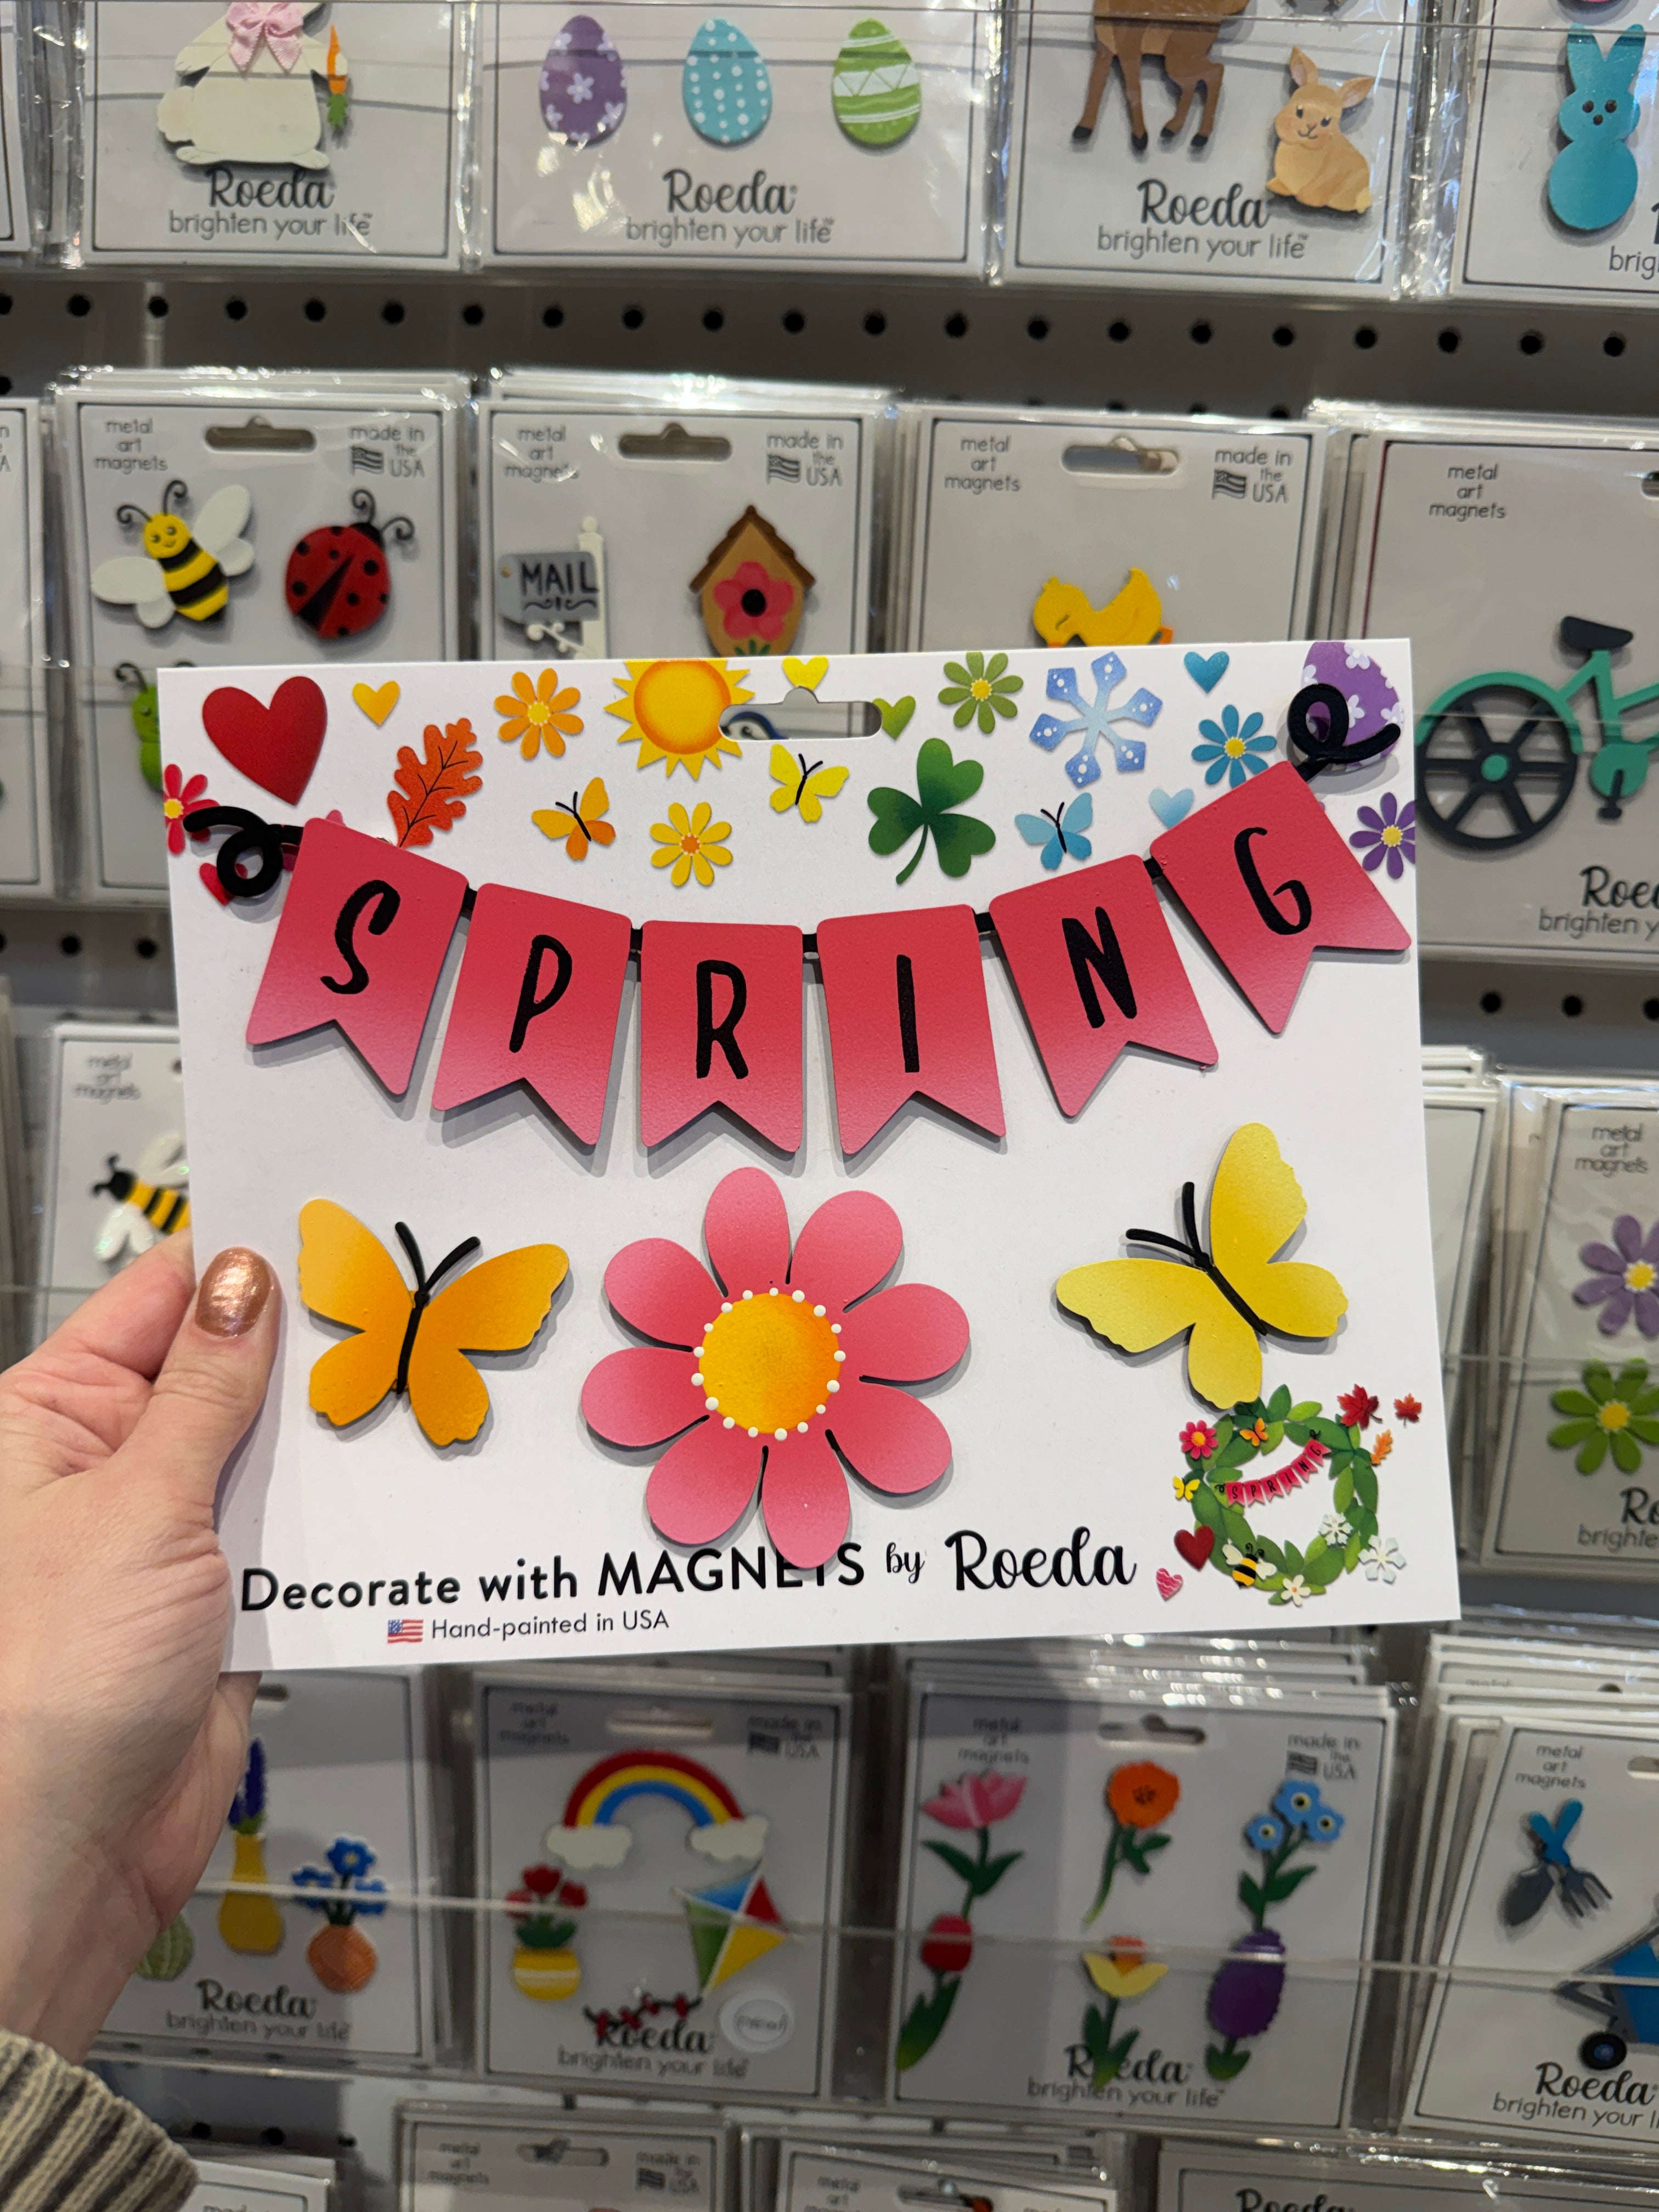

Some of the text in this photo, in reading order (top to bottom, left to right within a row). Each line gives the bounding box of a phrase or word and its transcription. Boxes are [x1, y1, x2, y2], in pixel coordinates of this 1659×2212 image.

[205, 166, 335, 209] Roeda
[1137, 178, 1271, 228] Roeda
[169, 210, 267, 241] brighten
[274, 219, 327, 241] your
[626, 217, 726, 249] brighten
[733, 225, 788, 249] your
[1097, 224, 1199, 260] brighten
[1207, 238, 1262, 262] your
[1609, 246, 1659, 280] brig
[105, 419, 153, 434] metal
[350, 425, 425, 442] made in
[516, 424, 566, 443] metal
[116, 438, 142, 453] art
[767, 430, 843, 450] made in
[960, 435, 1011, 453] metal
[527, 445, 554, 461] art
[1214, 445, 1293, 466] made in
[94, 455, 168, 475] magnets
[389, 459, 425, 478] USA
[970, 455, 998, 472] art
[1447, 463, 1499, 481] metal
[805, 467, 843, 487] USA
[944, 474, 1022, 495] magnets
[1259, 467, 1283, 482] the
[1252, 483, 1289, 504] USA
[1457, 483, 1483, 500] art
[1428, 502, 1506, 522] magnets
[520, 560, 599, 596] MAIL
[1538, 907, 1639, 940] brighten
[1592, 1123, 1644, 1142] metal
[1575, 1156, 1650, 1178] magnets
[241, 1526, 1137, 1611] Decorate with MAGNES by Roeda
[432, 1609, 670, 1641] Hand-painted in USA
[1536, 1744, 1584, 1760] metal
[1542, 1760, 1569, 1773] art
[1515, 1772, 1587, 1791] magnets
[195, 1978, 317, 2019] Roeda
[1064, 2042, 1189, 2084] Reda
[1535, 2061, 1656, 2106] Roeda
[1128, 2087, 1177, 2107] your
[1493, 2091, 1587, 2121] brighten
[1592, 2109, 1644, 2128] your
